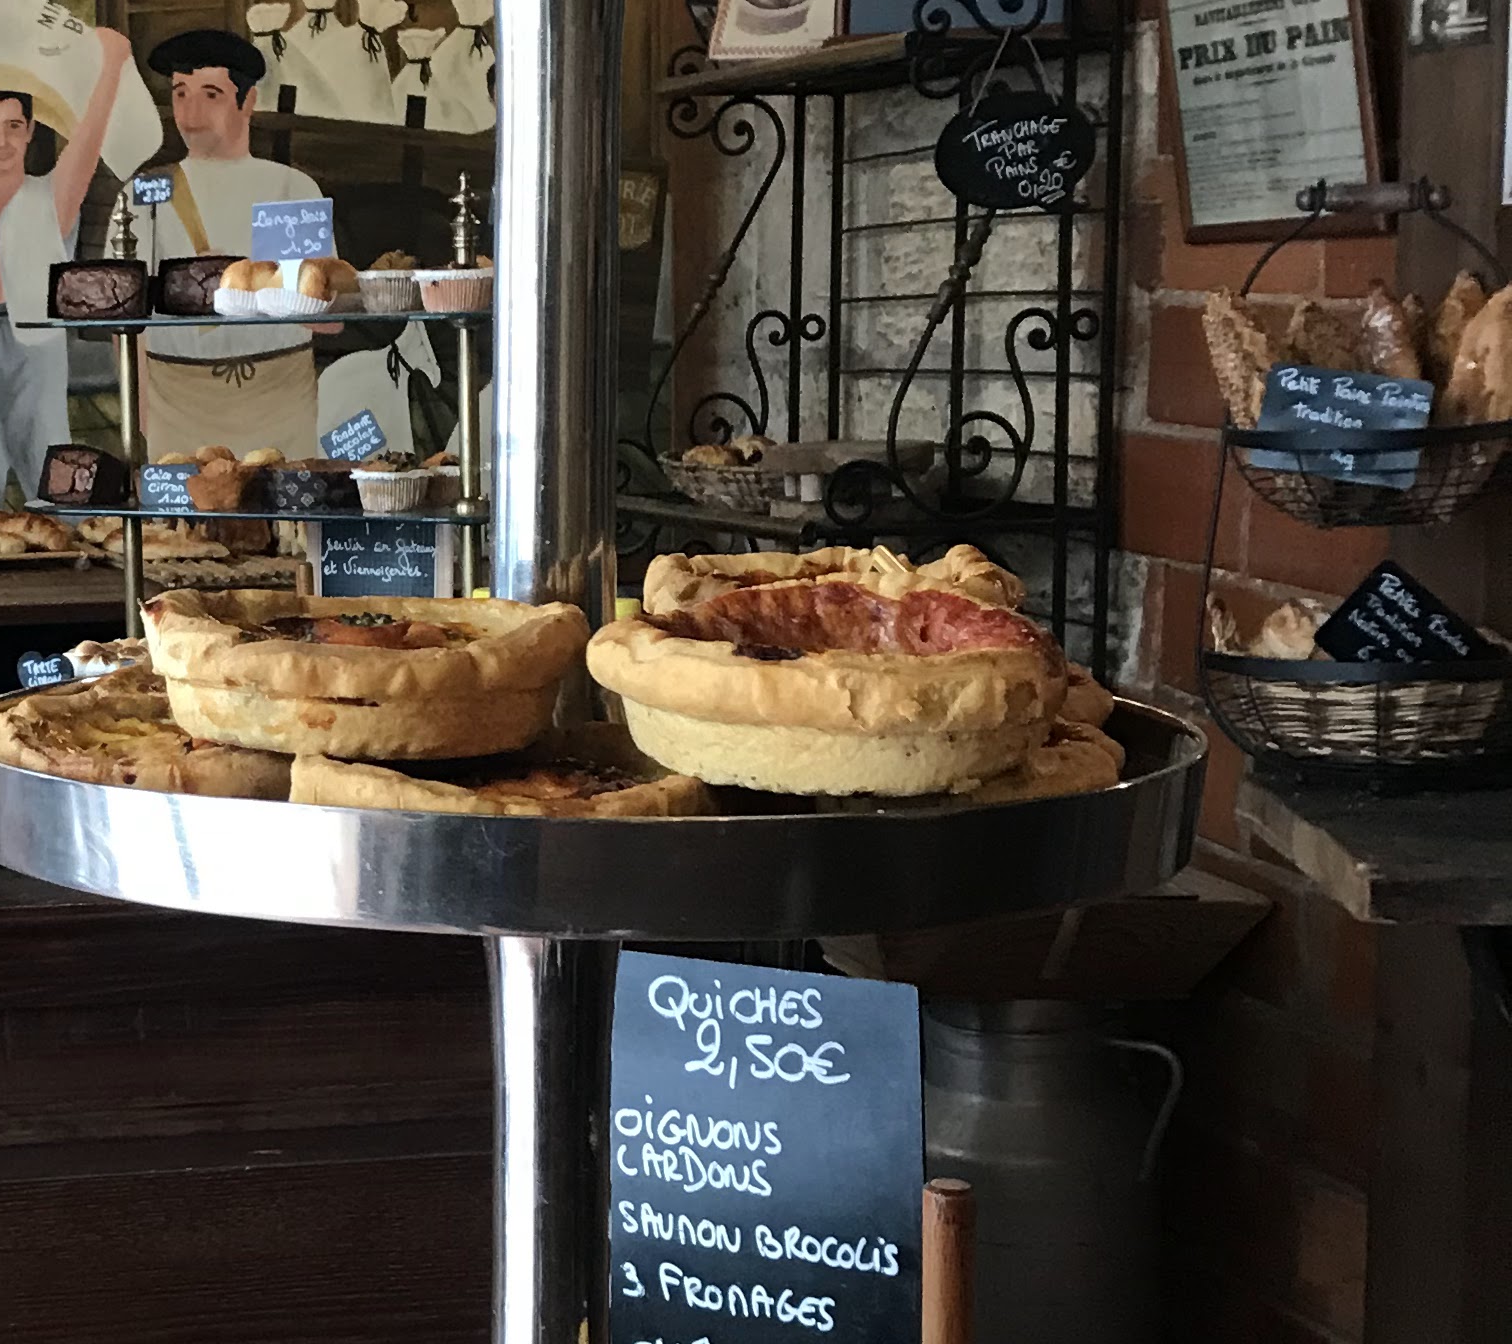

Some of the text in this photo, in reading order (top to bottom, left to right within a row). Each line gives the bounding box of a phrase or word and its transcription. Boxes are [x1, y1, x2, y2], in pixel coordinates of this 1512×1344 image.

[1178, 37, 1237, 71] PRIX
[1244, 29, 1277, 58] DU
[1286, 16, 1352, 51] PAIN
[683, 1017, 852, 1090] 2,50€
[614, 1093, 783, 1156] OIGNONS
[754, 1223, 900, 1278] BROCOLIS
[619, 1261, 646, 1298] 3
